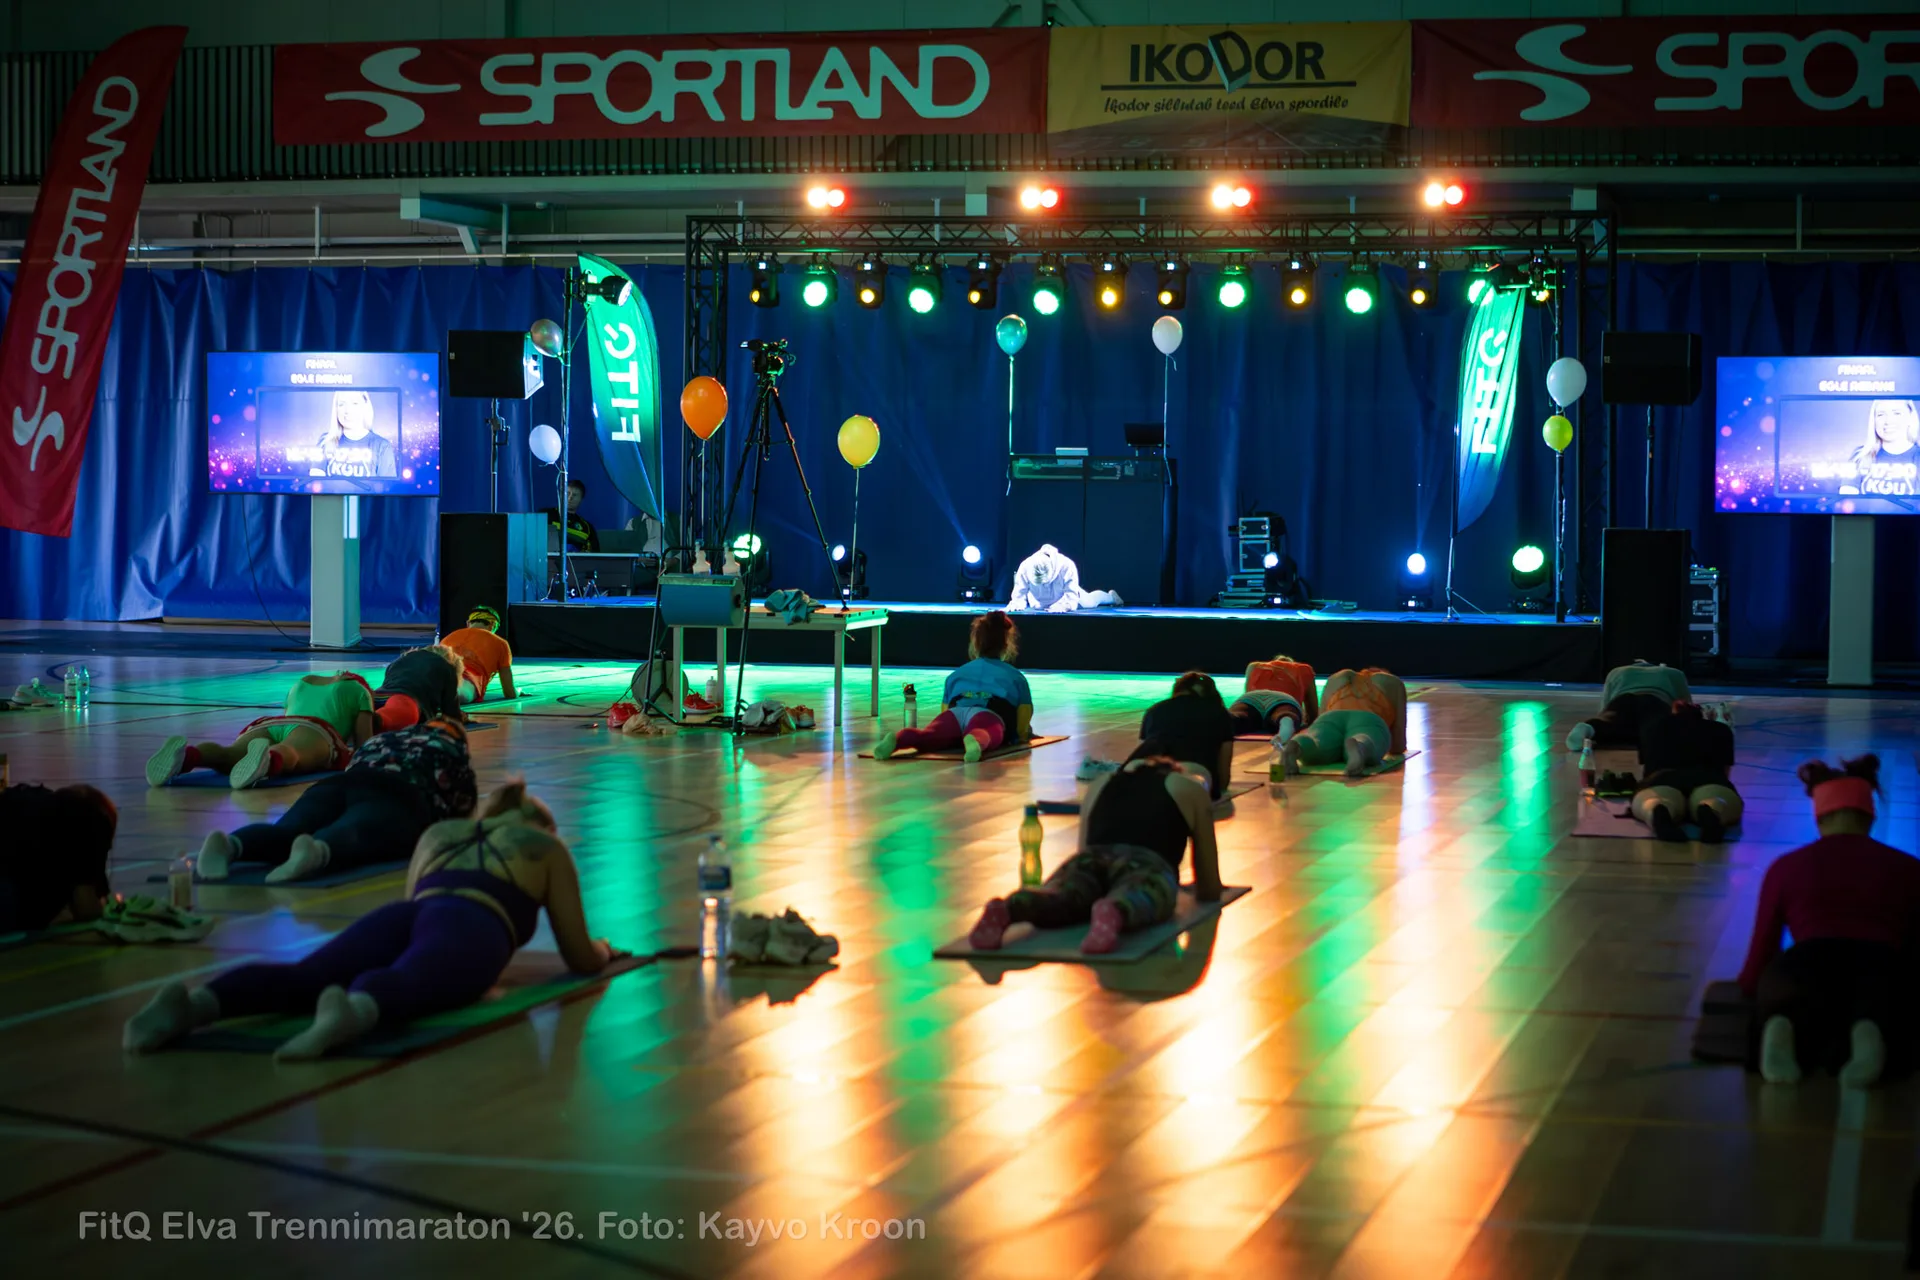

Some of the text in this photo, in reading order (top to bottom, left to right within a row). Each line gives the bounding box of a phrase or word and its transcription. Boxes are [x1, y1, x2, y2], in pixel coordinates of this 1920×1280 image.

[479, 44, 990, 125] SPORTLAND
[1129, 31, 1326, 93] IKODOR
[1104, 95, 1349, 114] Ikodor sillutab teed Elva spordile
[31, 75, 140, 380] SPORTLAND
